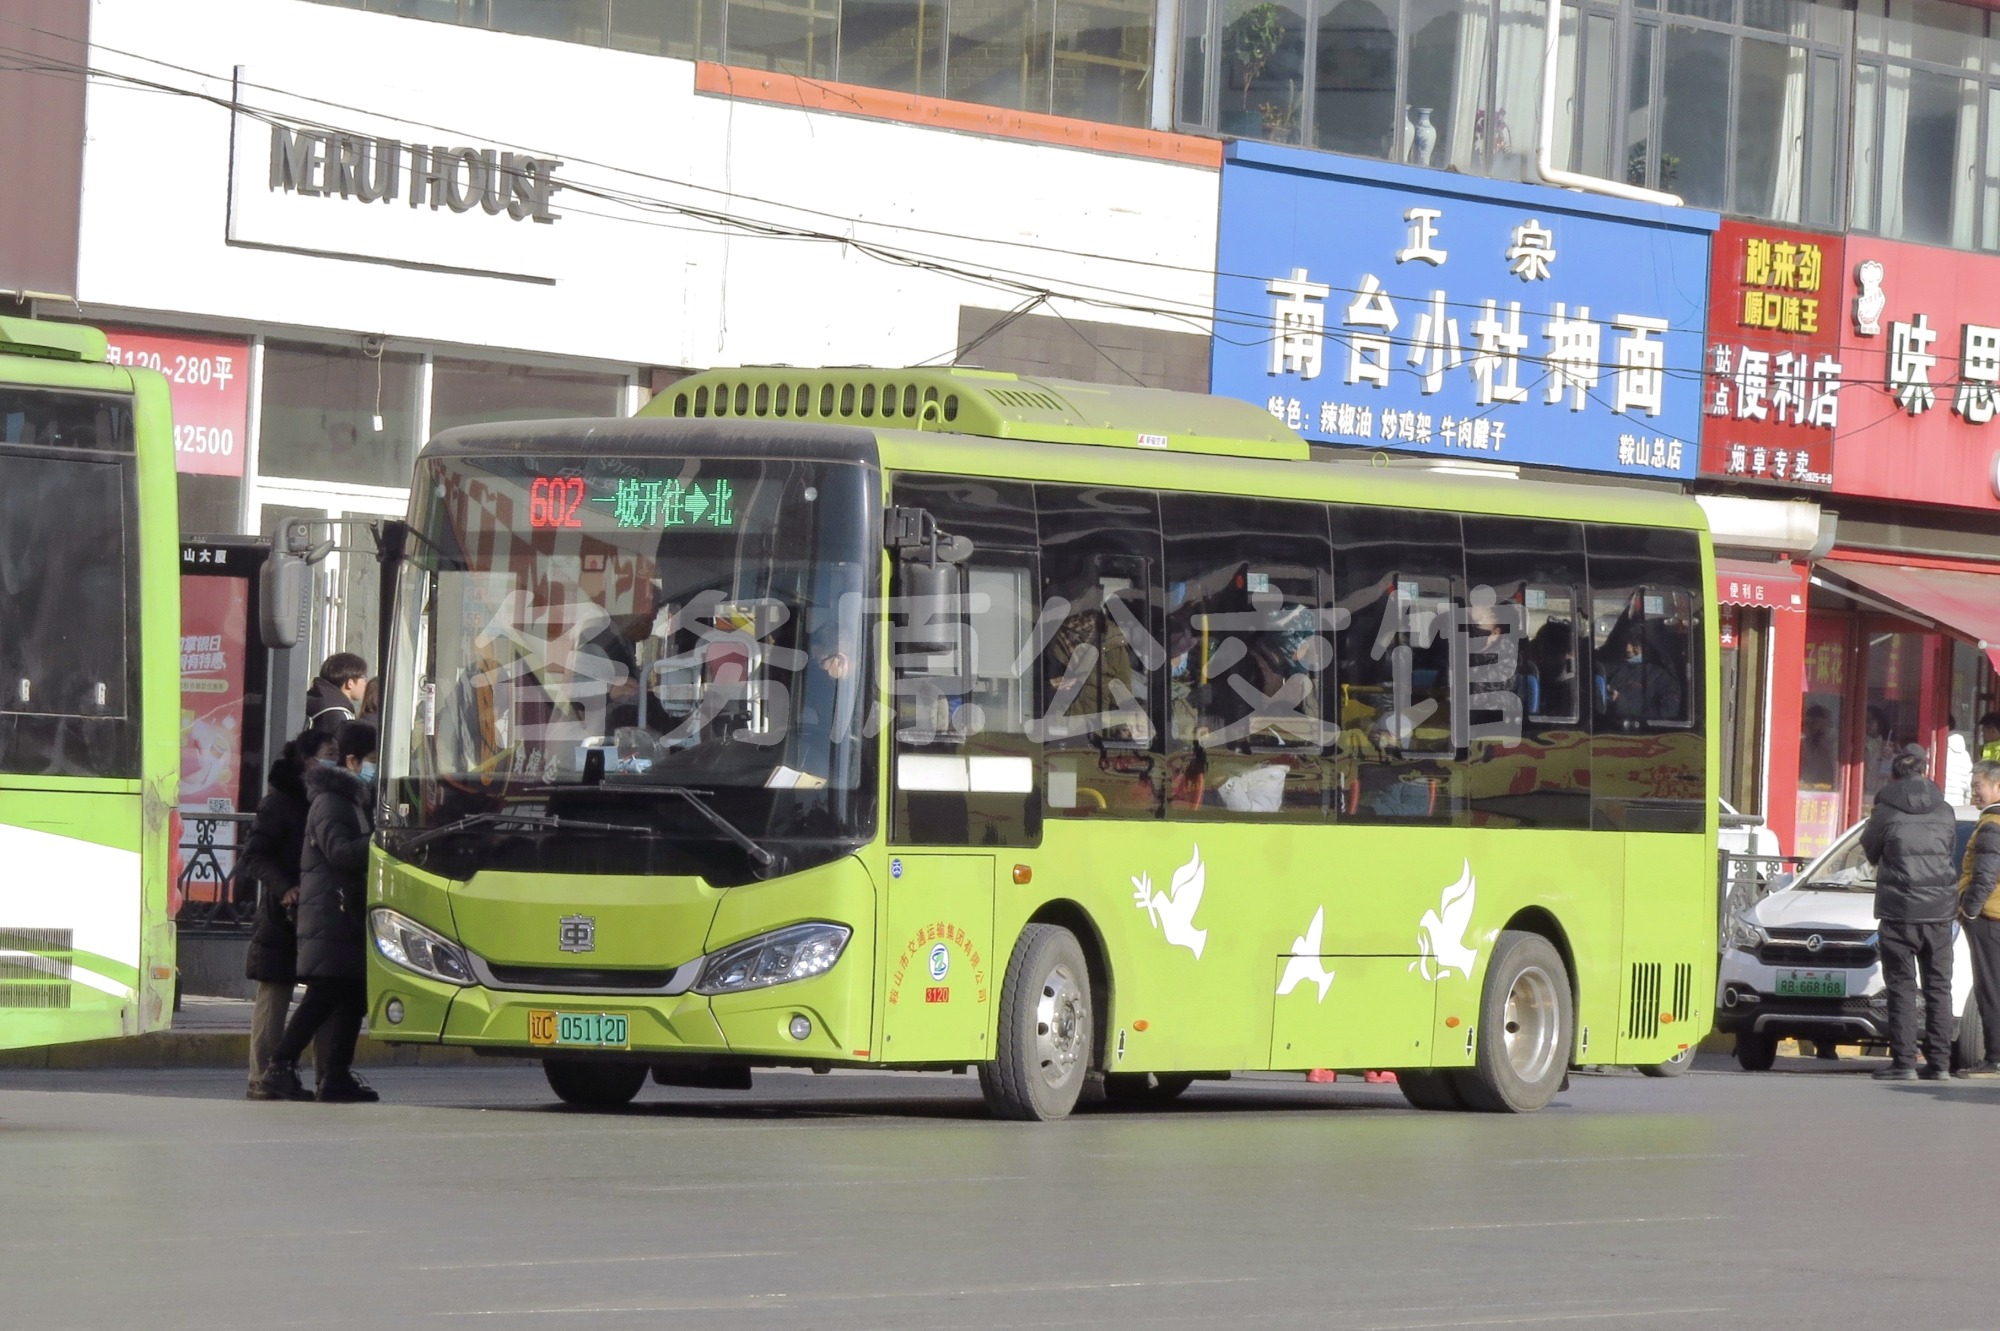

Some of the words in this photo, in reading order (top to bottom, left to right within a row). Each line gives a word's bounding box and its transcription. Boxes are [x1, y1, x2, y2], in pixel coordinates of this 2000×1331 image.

[270, 125, 400, 204] MERUI
[409, 146, 564, 225] HOUSE
[1397, 207, 1556, 282] 正宗
[1746, 238, 1822, 291] 秒来劲
[1744, 291, 1819, 333] 嚼口味王
[1266, 268, 1669, 418] 南台小杜抻面
[1712, 345, 1732, 416] 站点
[1735, 346, 1842, 428] 便利店
[1319, 401, 1372, 438] 辣椒油
[1380, 407, 1432, 443] 炒鸡架
[1439, 414, 1507, 451] 牛肉腱子
[1618, 433, 1683, 471] 鞍山总店
[1731, 443, 1809, 478] 烟草专卖
[530, 476, 585, 528] 602
[183, 548, 227, 564] 山大厦
[1729, 582, 1765, 601] 便利店
[926, 988, 949, 1002] 3120
